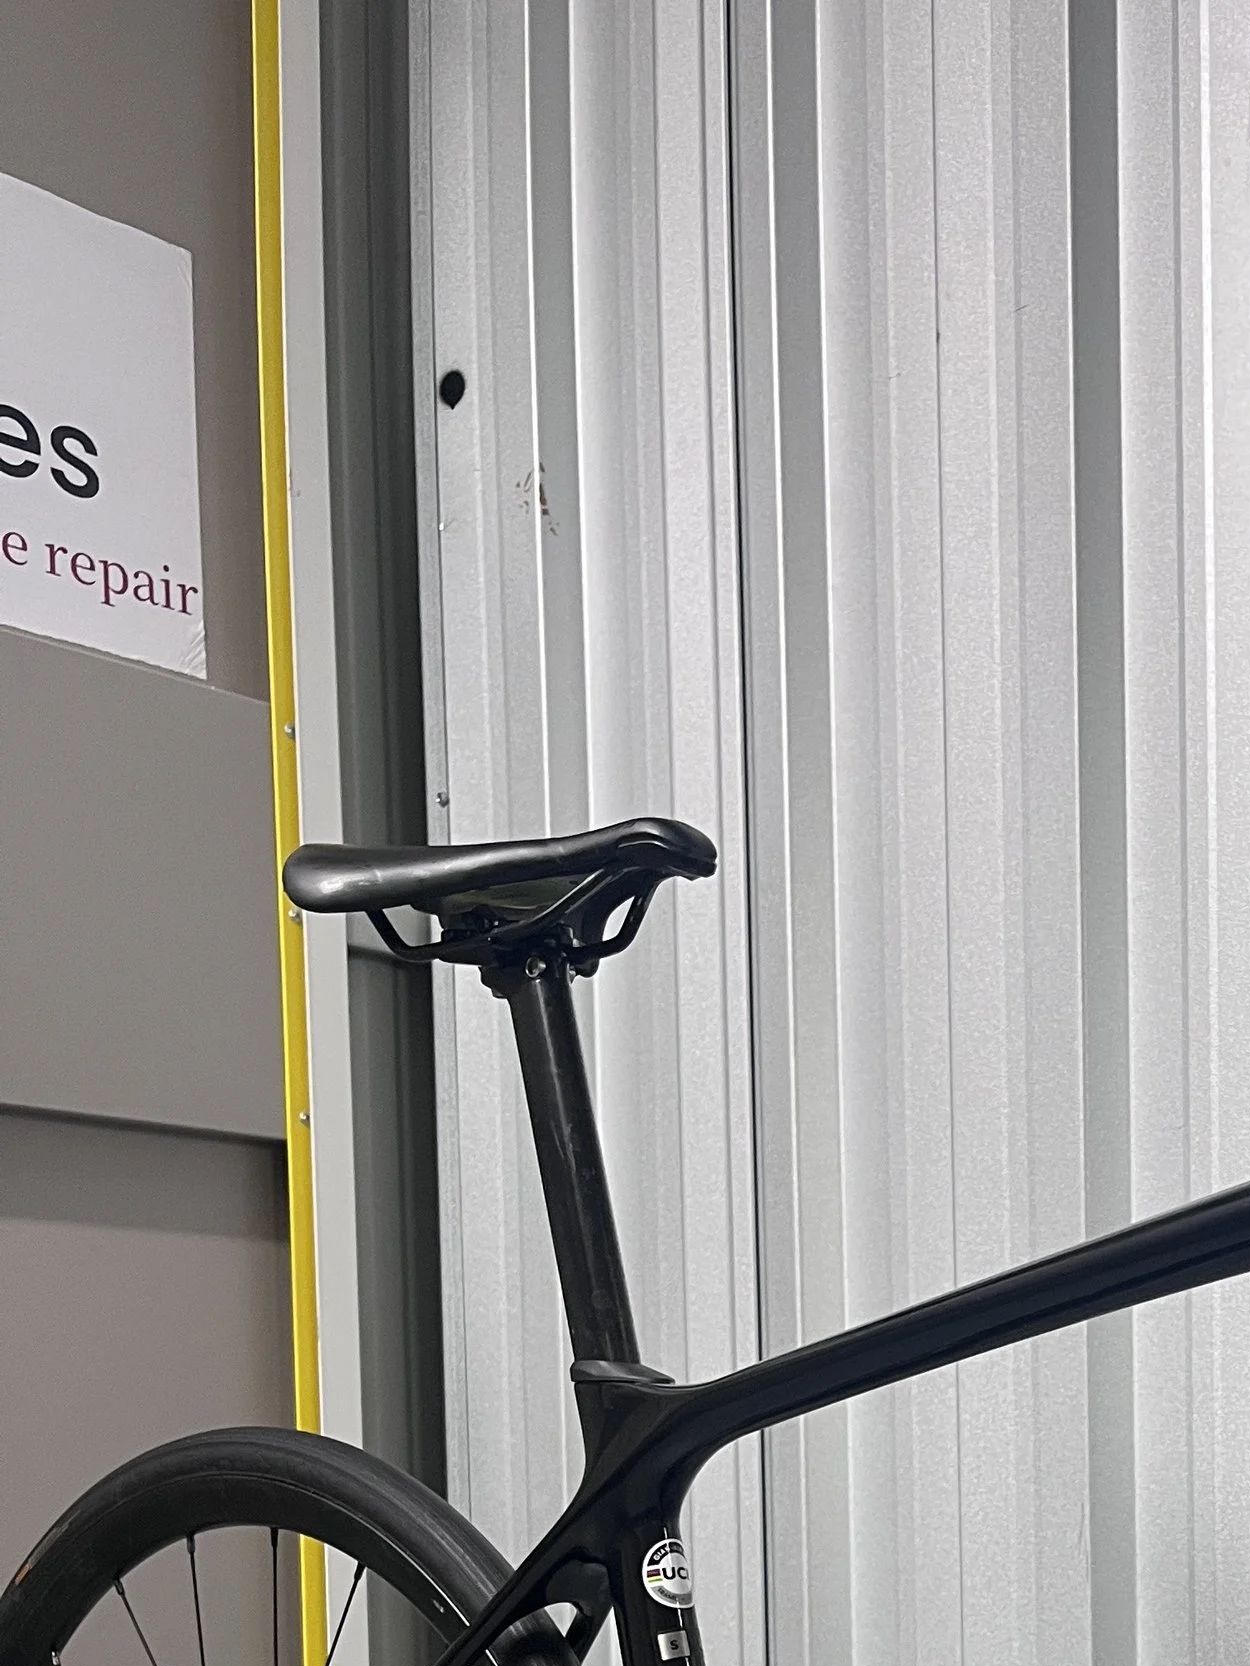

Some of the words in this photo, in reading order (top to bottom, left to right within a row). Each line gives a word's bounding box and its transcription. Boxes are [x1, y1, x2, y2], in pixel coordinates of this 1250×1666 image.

[1, 531, 28, 566] e
[45, 542, 198, 615] repair
[670, 1640, 678, 1650] S
